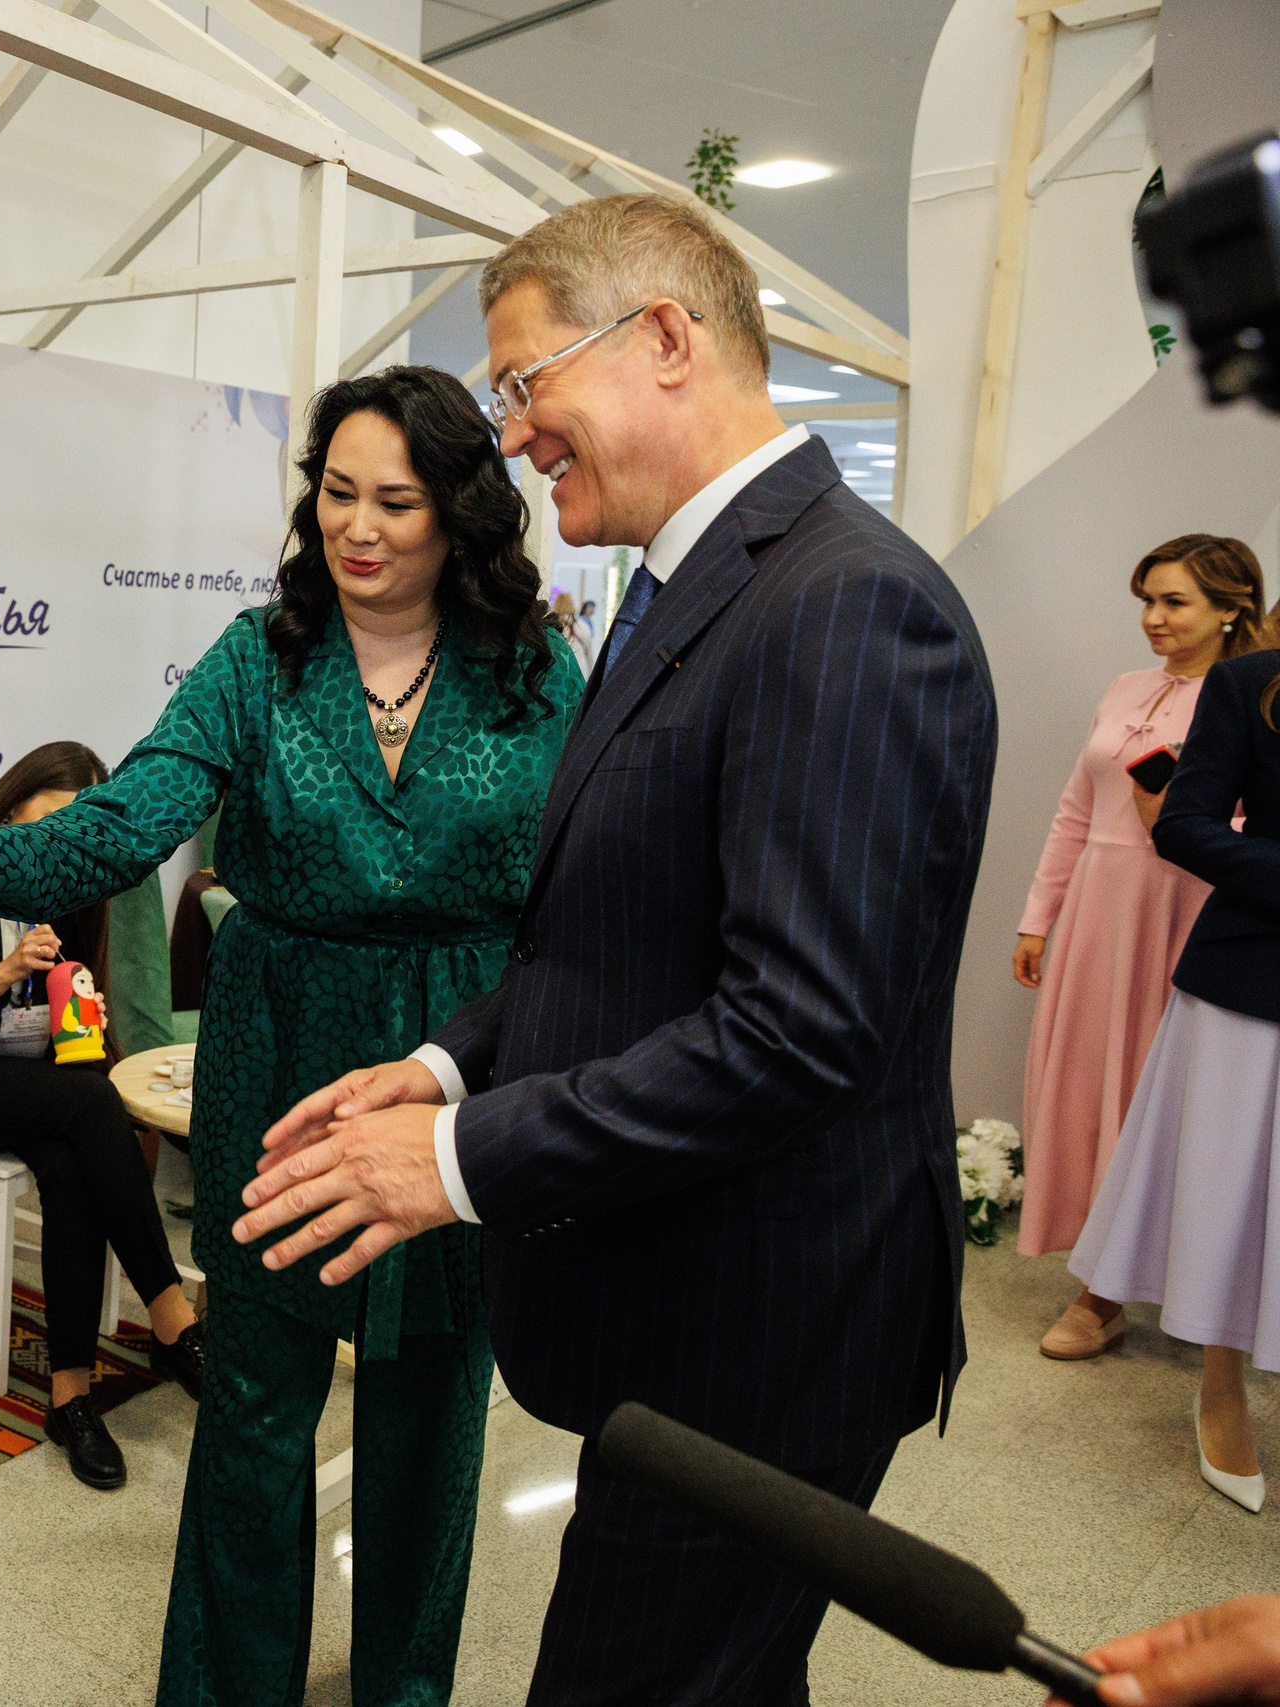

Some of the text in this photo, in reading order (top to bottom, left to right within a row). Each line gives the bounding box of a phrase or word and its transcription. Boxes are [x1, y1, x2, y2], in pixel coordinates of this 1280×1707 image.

[103, 563, 180, 590] Счастье
[185, 573, 195, 590] в
[199, 569, 247, 596] тебе,
